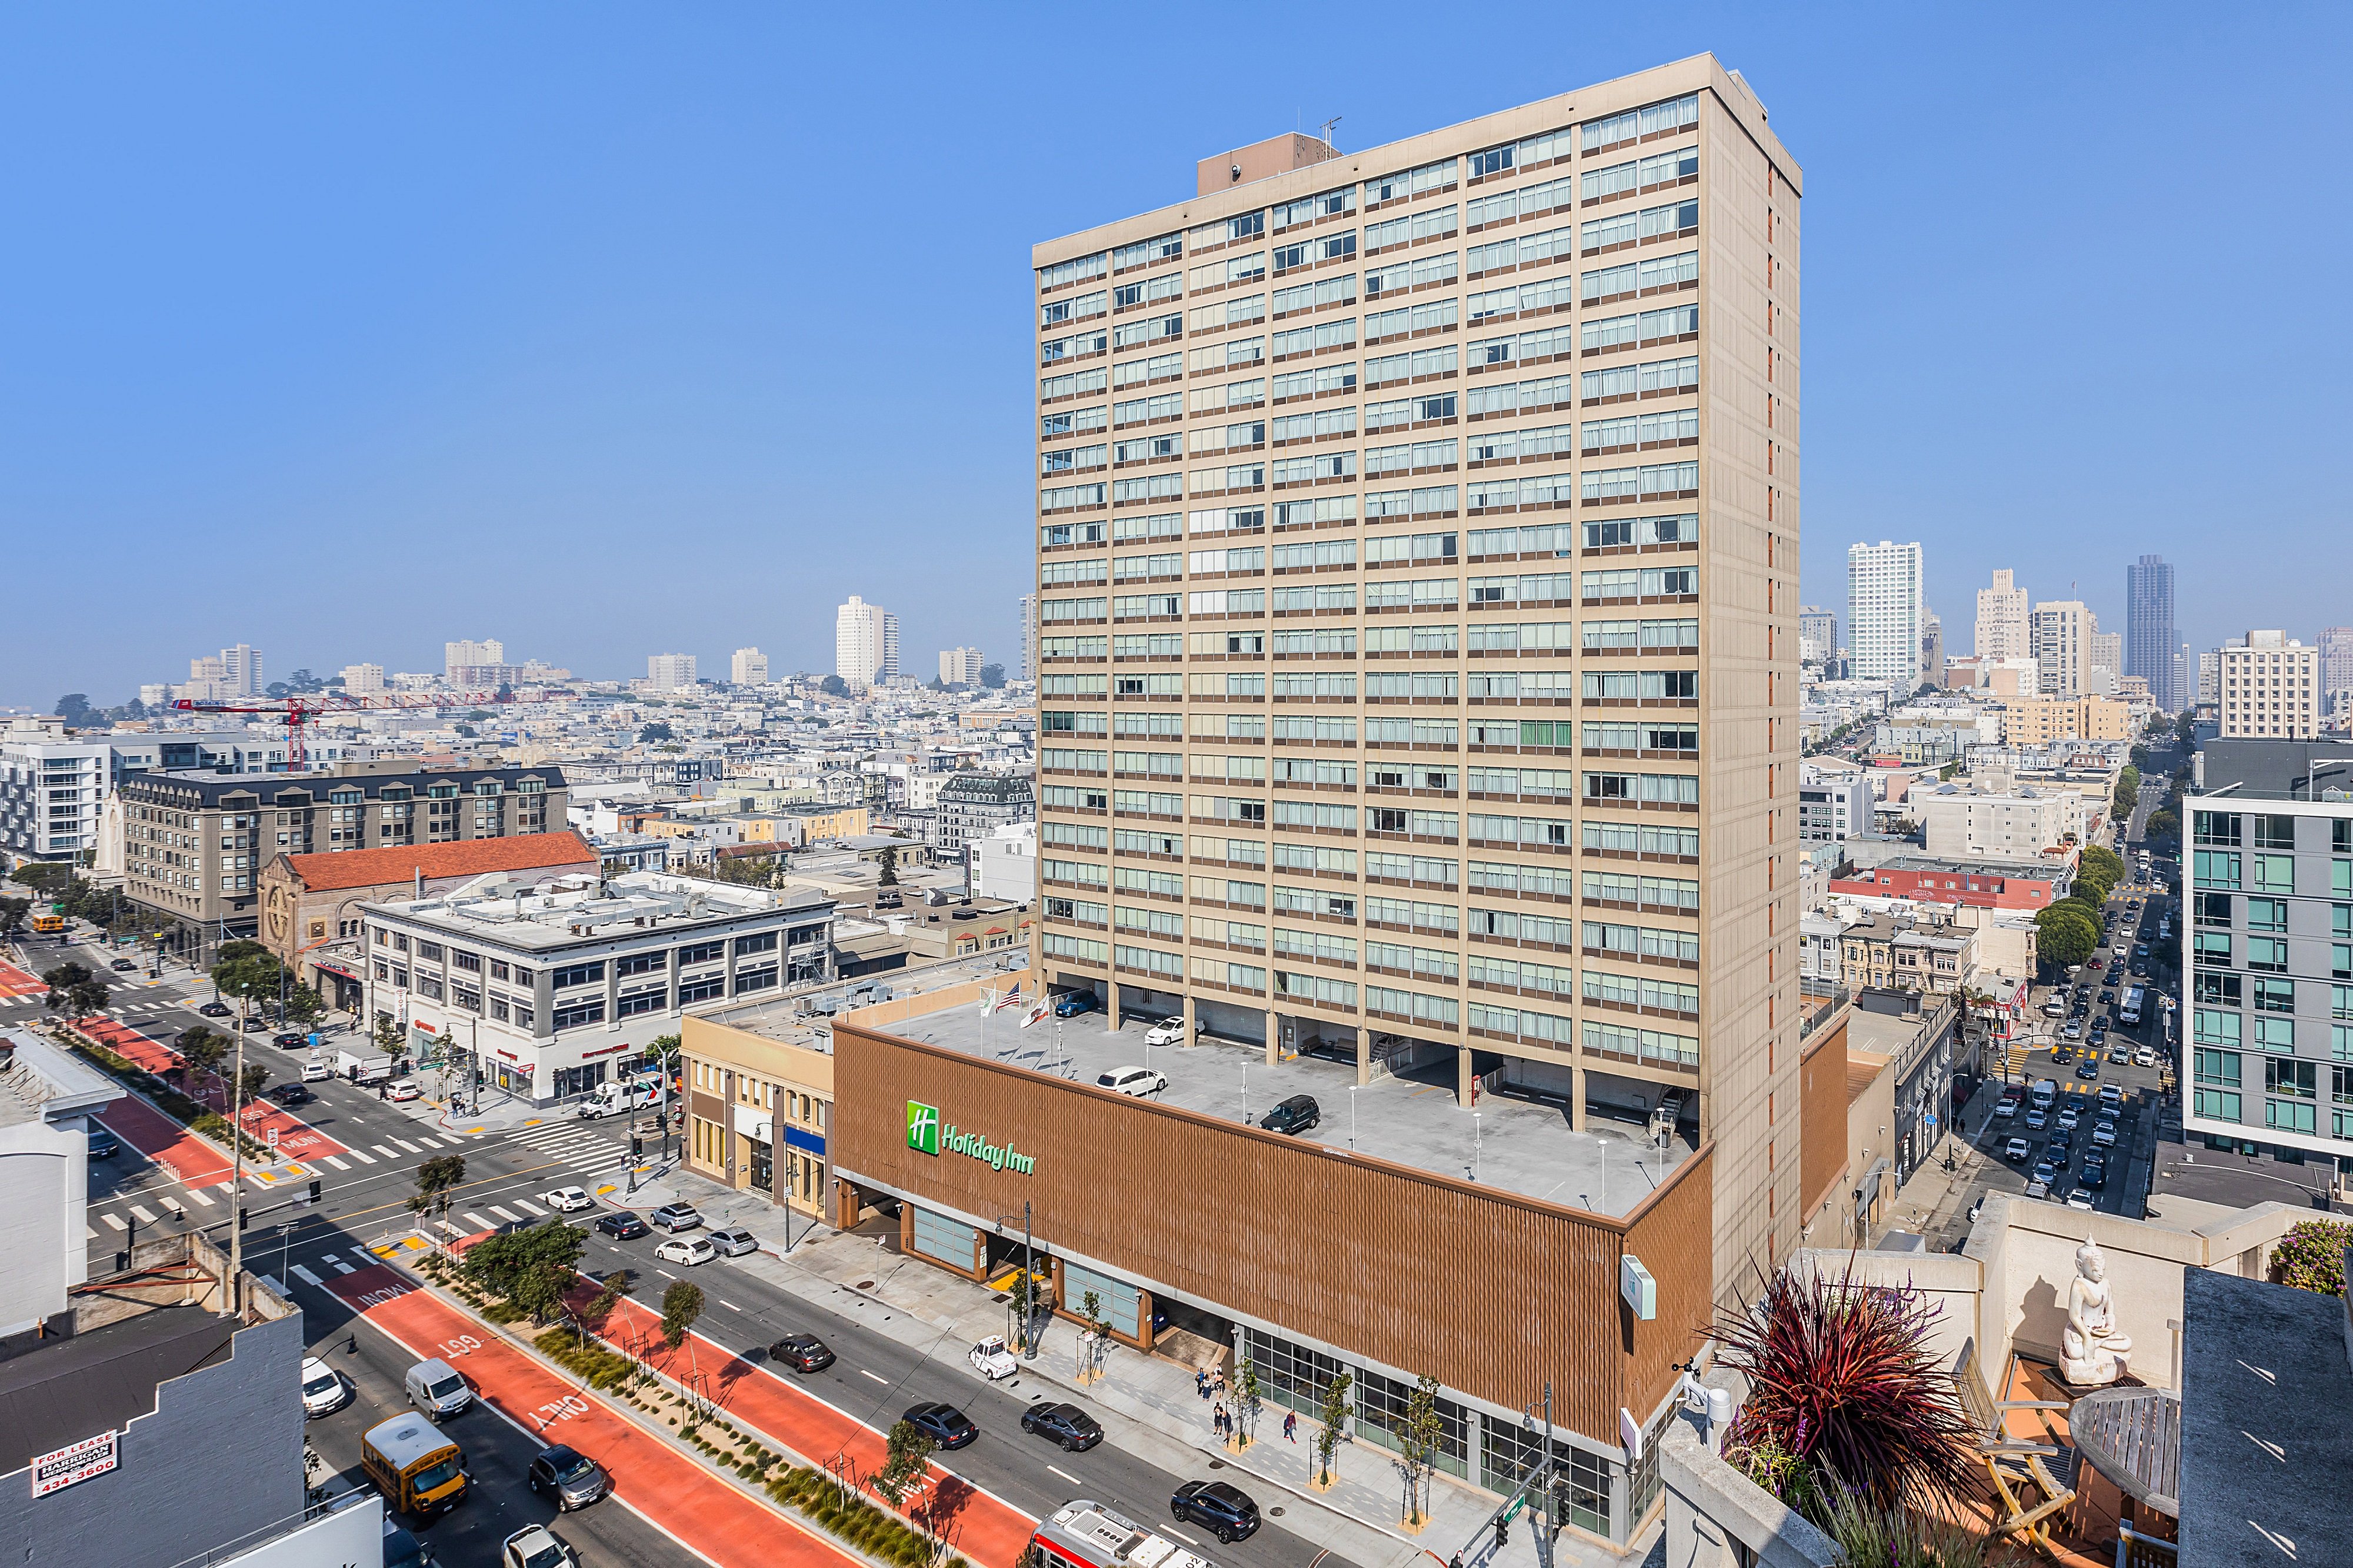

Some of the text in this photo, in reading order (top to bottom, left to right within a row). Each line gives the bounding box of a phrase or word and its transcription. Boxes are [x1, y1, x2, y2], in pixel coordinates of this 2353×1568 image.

[281, 1135, 322, 1150] MUNI
[942, 1123, 1034, 1175] Holiday Inn
[358, 1283, 412, 1308] MUNI
[438, 1335, 481, 1359] GGT
[528, 1395, 589, 1431] ONLY
[39, 1434, 112, 1464] FOR LEASE
[42, 1444, 109, 1474] HARRIGAN
[42, 1460, 114, 1492] 434-3600
